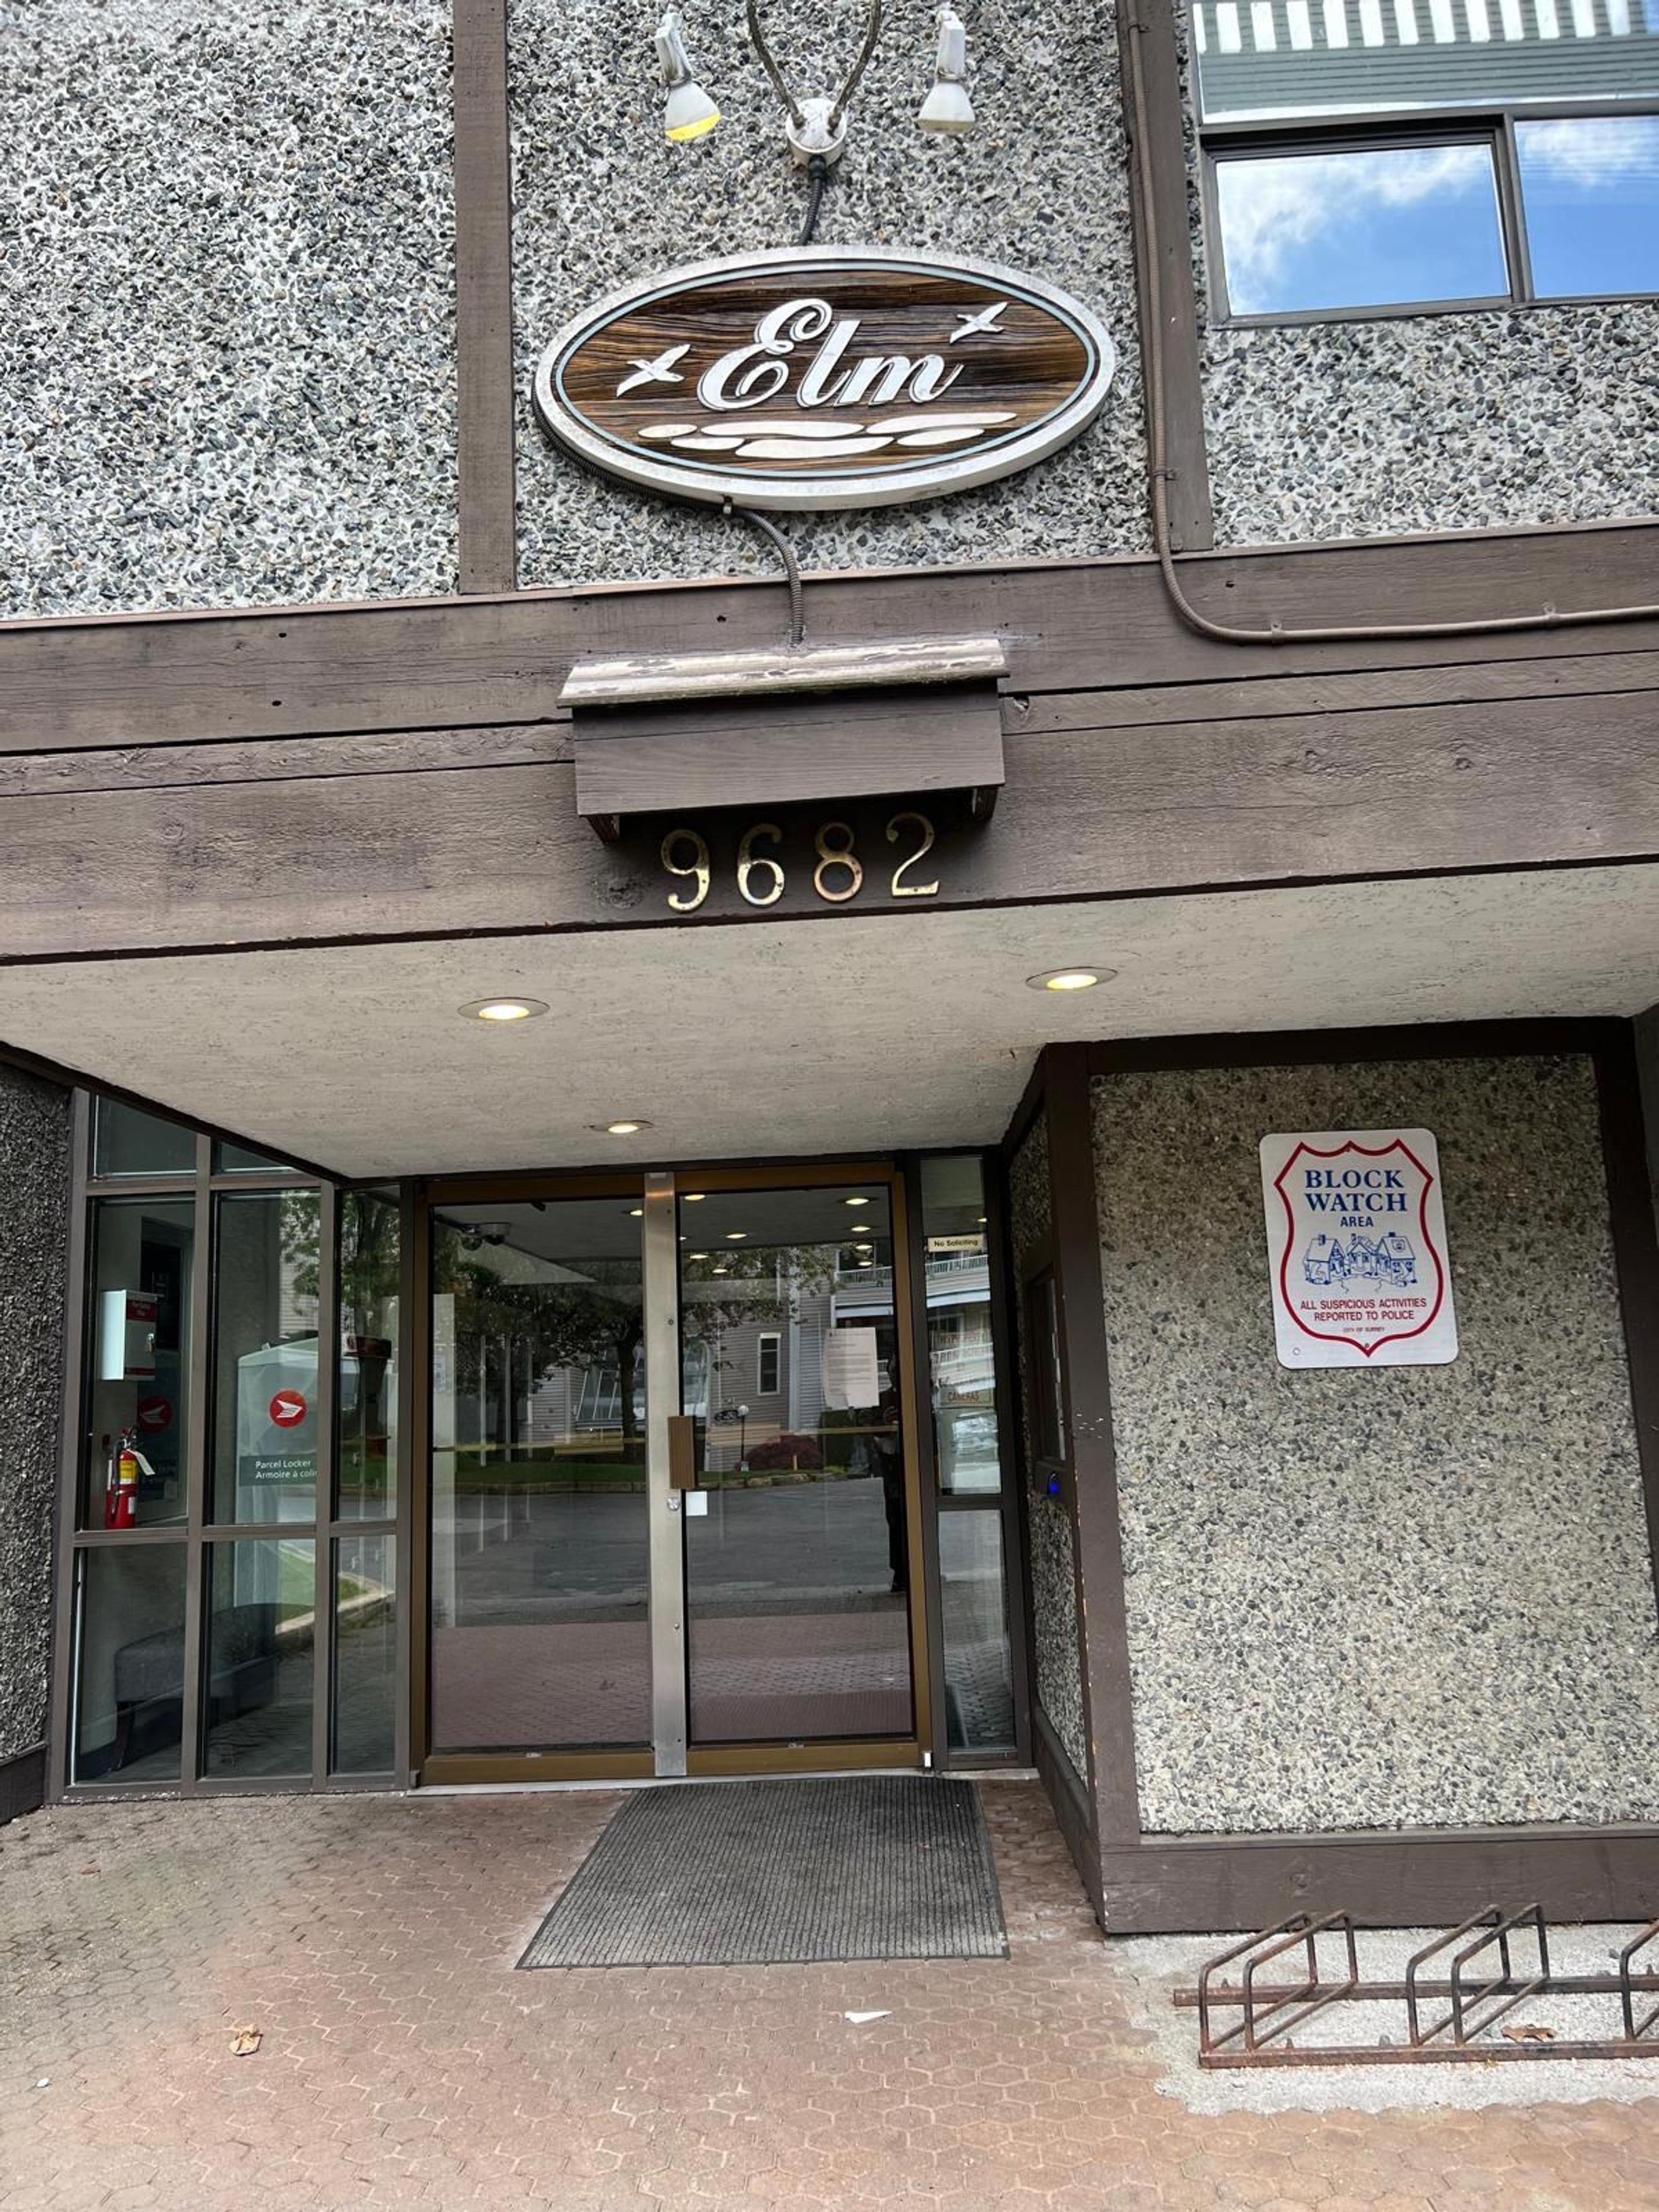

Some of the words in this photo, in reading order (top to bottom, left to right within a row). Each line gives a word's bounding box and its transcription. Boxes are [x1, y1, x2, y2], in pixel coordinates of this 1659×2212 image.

[697, 298, 964, 411] Elm
[661, 812, 940, 914] 9682
[1305, 1170, 1404, 1188] BLOCK
[1304, 1193, 1407, 1211] WATCH
[1340, 1216, 1374, 1227] AREA
[1301, 1300, 1316, 1310] ALL
[1320, 1299, 1375, 1309] SUSPICIOUS
[1379, 1298, 1427, 1307] ACTIVITIES
[1315, 1312, 1362, 1321] REPORTED
[1365, 1311, 1378, 1320] TO
[1382, 1310, 1414, 1319] POLICE
[256, 1460, 281, 1468] Parcel
[283, 1459, 311, 1468] Locker
